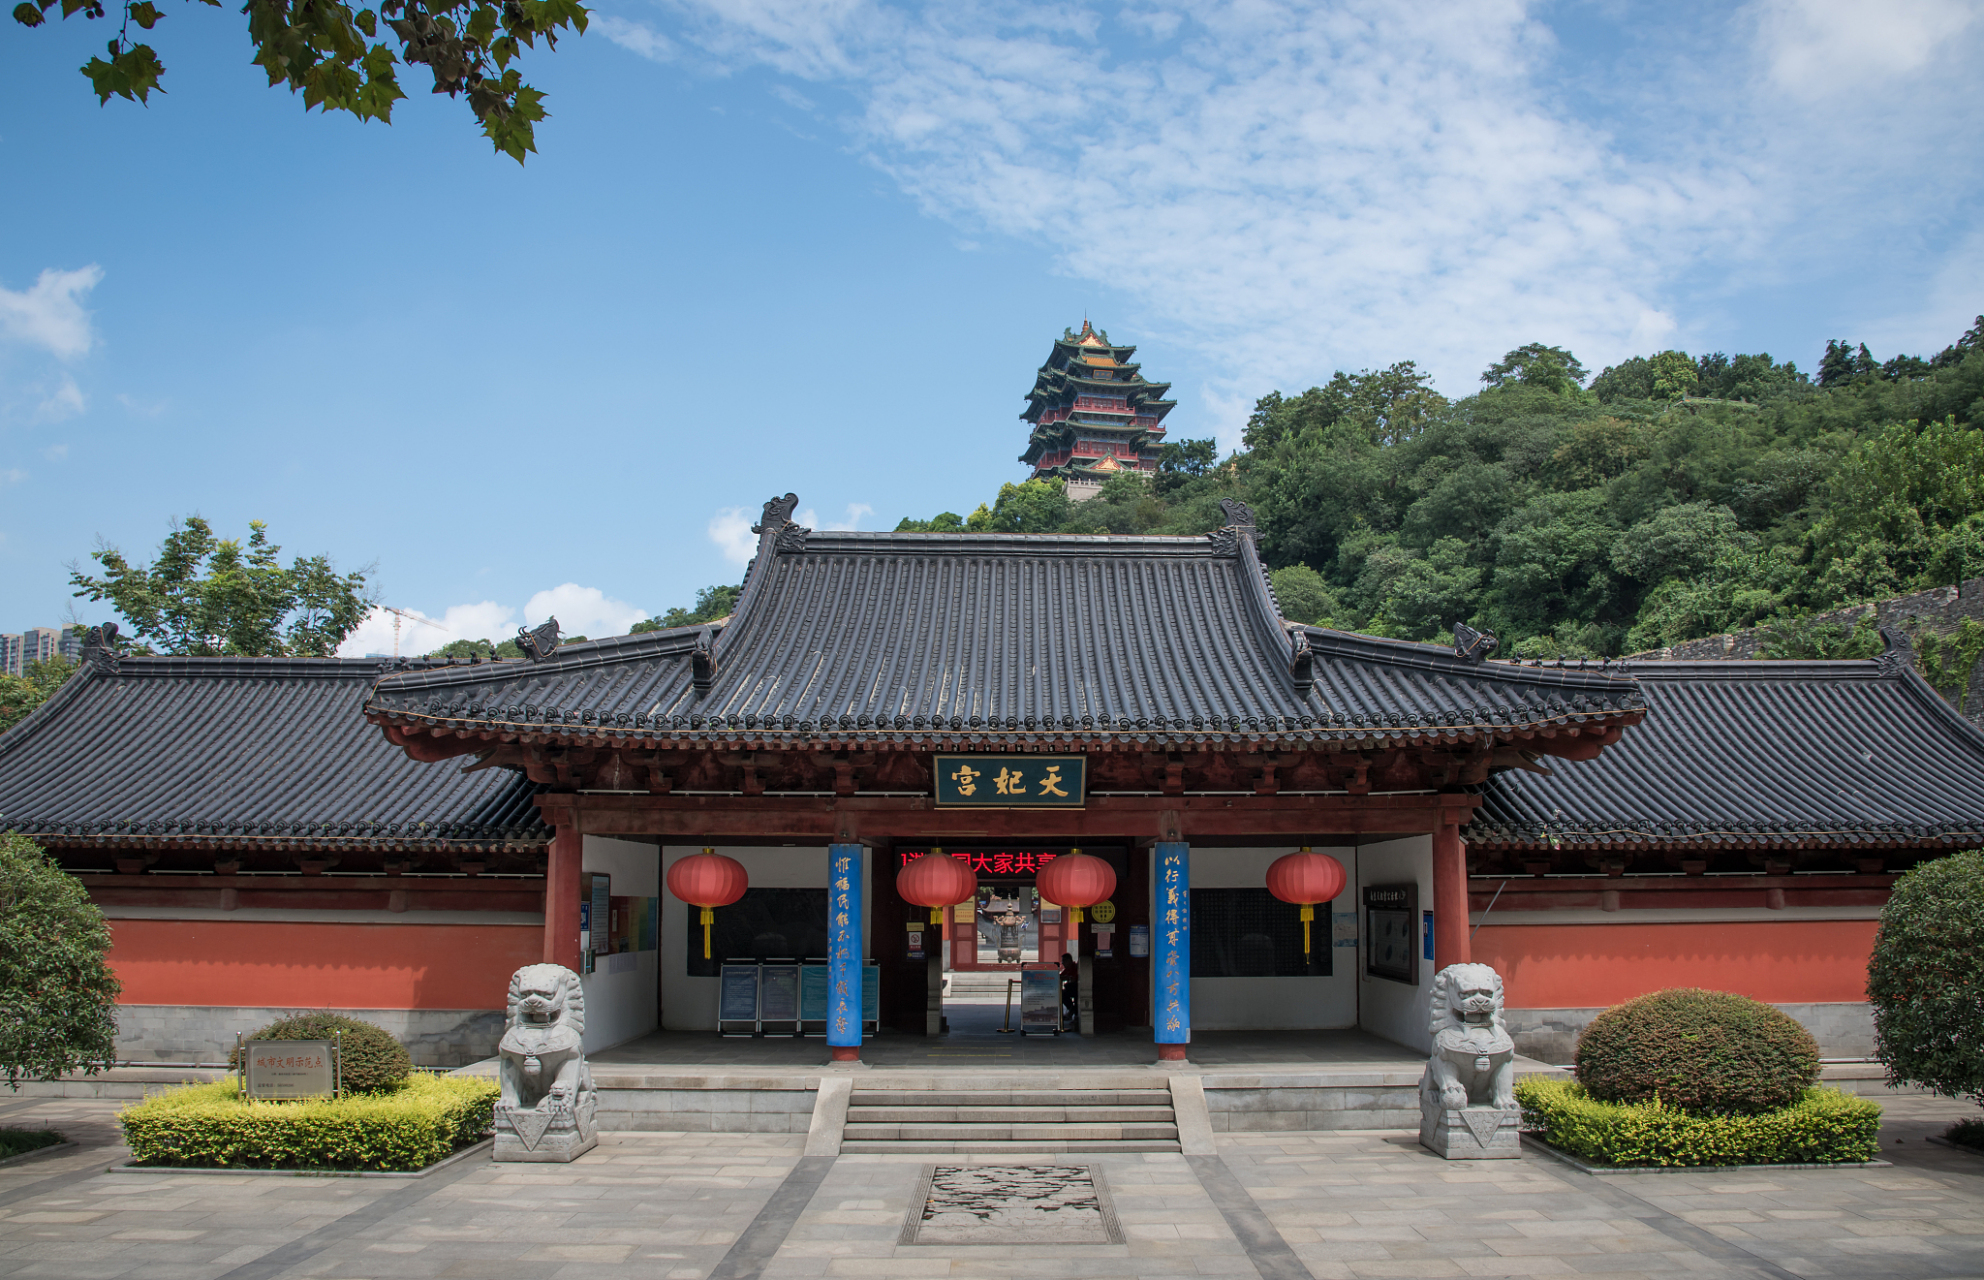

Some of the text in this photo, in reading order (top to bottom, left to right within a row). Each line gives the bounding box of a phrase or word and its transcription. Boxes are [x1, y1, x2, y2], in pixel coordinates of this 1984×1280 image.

[256, 1055, 324, 1070] 城市文明示范点
